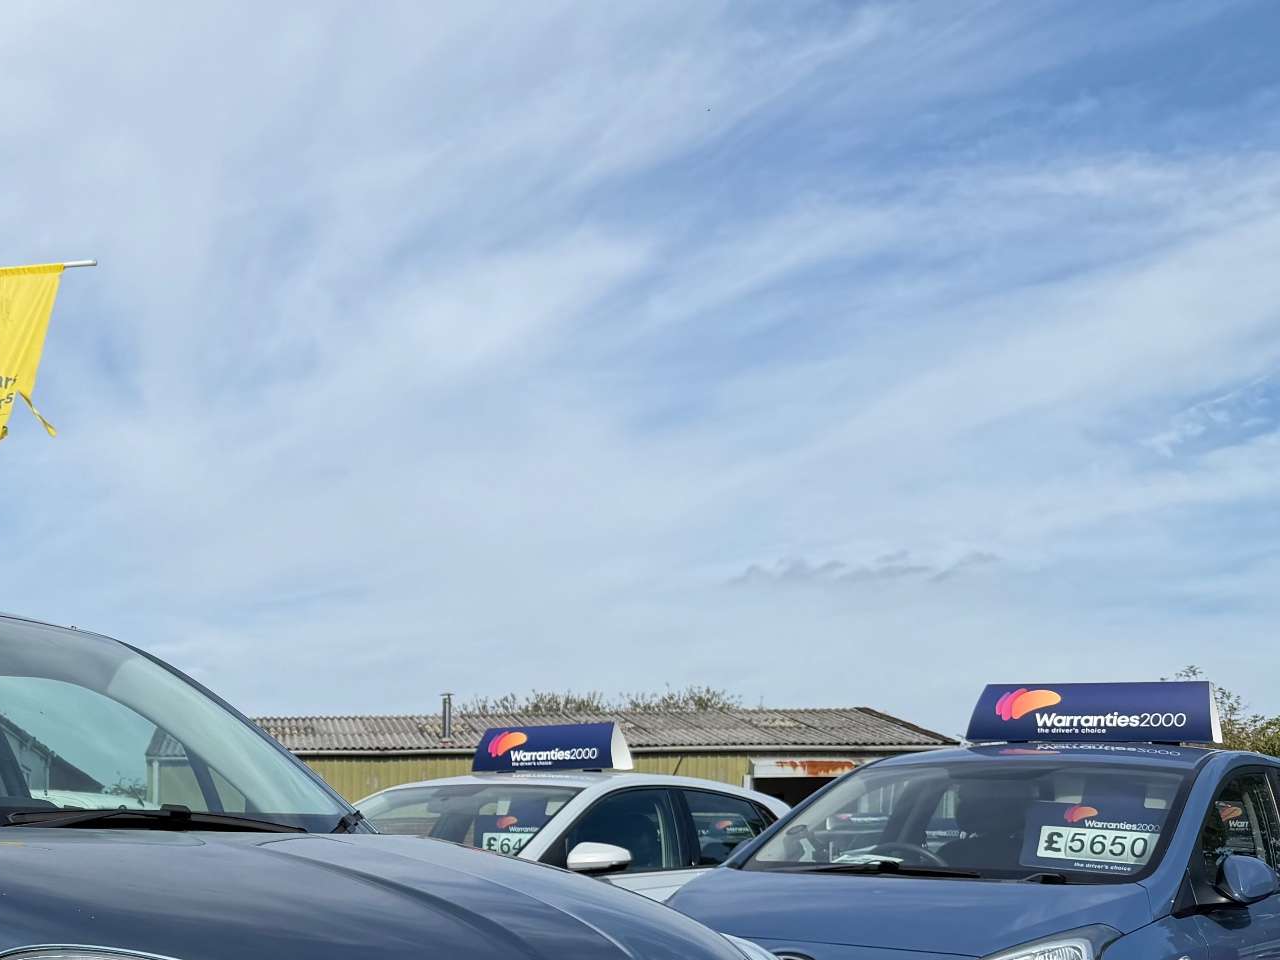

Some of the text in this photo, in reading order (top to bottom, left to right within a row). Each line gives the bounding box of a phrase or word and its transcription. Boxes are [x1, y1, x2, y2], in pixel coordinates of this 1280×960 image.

[1035, 711, 1187, 728] Warranties2000
[509, 748, 598, 762] Warranties2000
[1084, 819, 1160, 832] Warranties2000
[1043, 831, 1149, 859] £5650
